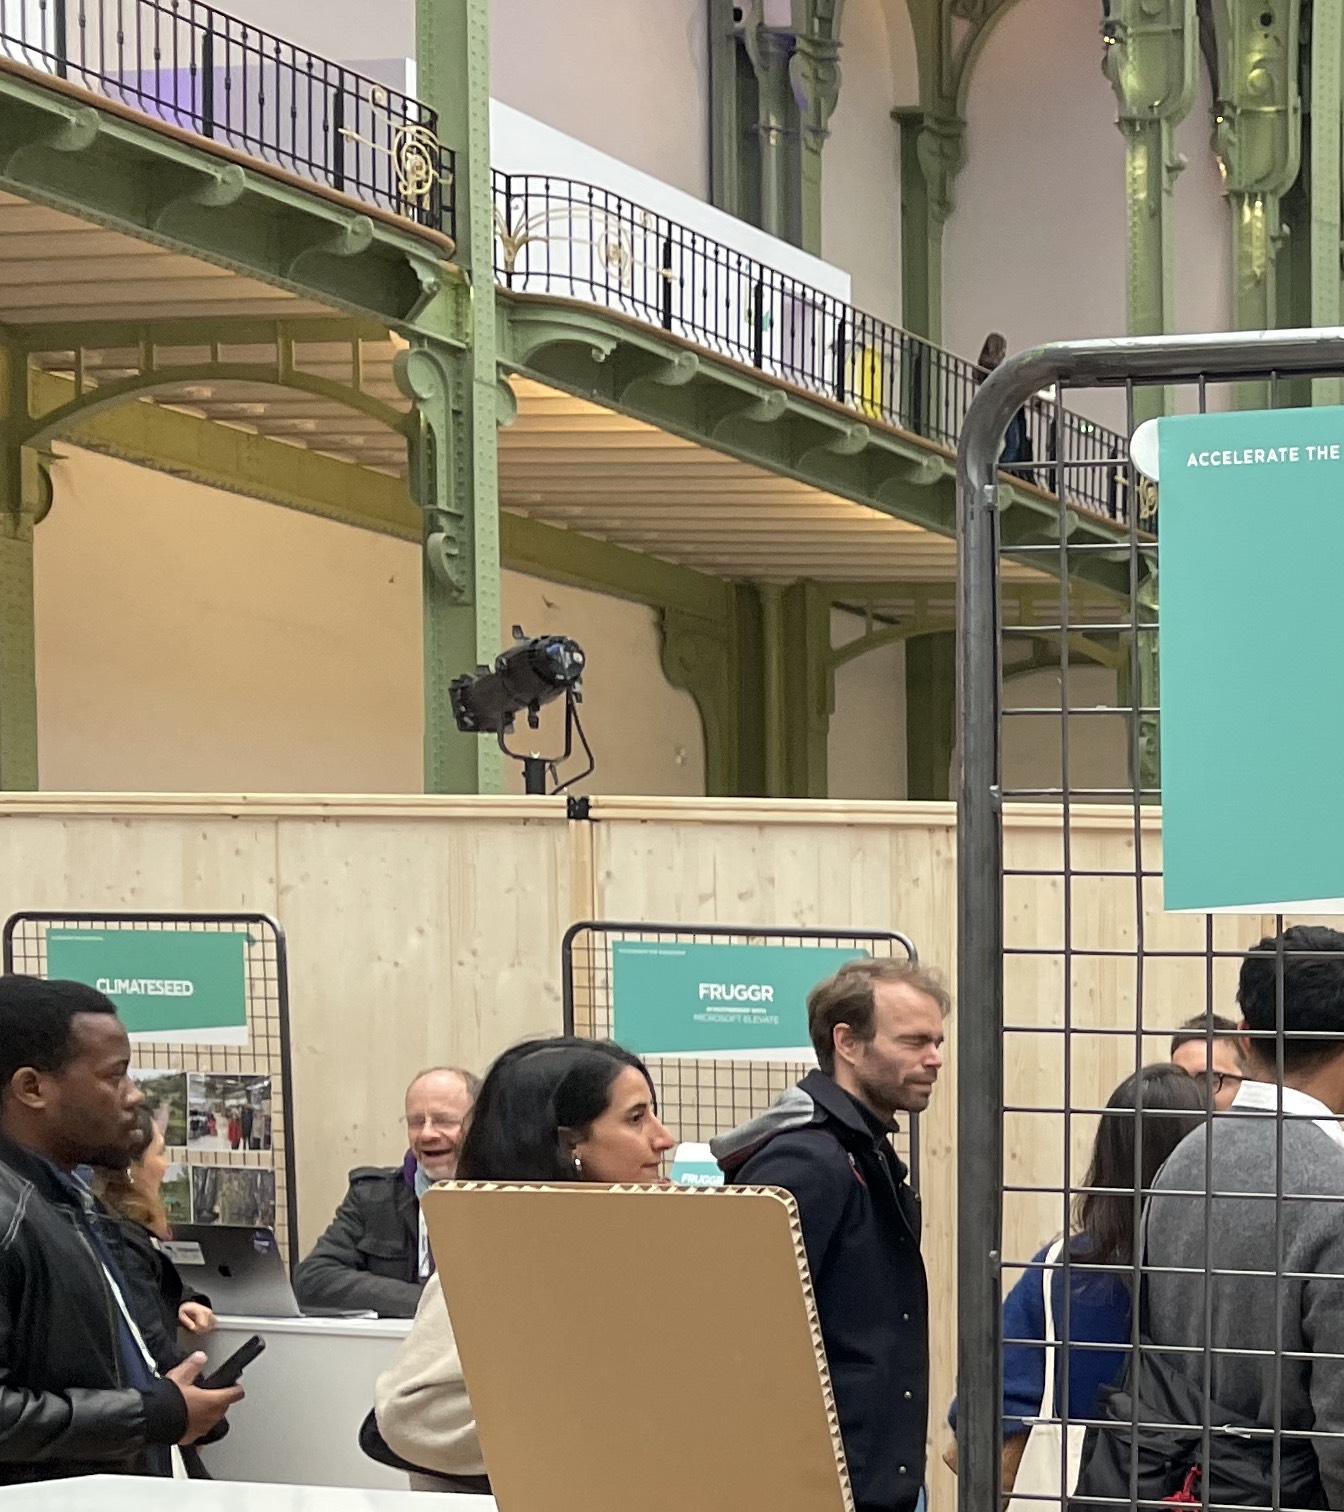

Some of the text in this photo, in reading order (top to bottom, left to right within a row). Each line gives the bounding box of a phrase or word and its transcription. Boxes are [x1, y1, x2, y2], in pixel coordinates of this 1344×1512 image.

[1187, 446, 1300, 468] ACCELERATE
[1305, 444, 1340, 461] THE
[96, 977, 194, 996] CLIMATESEED
[698, 983, 774, 1002] FRUGGR
